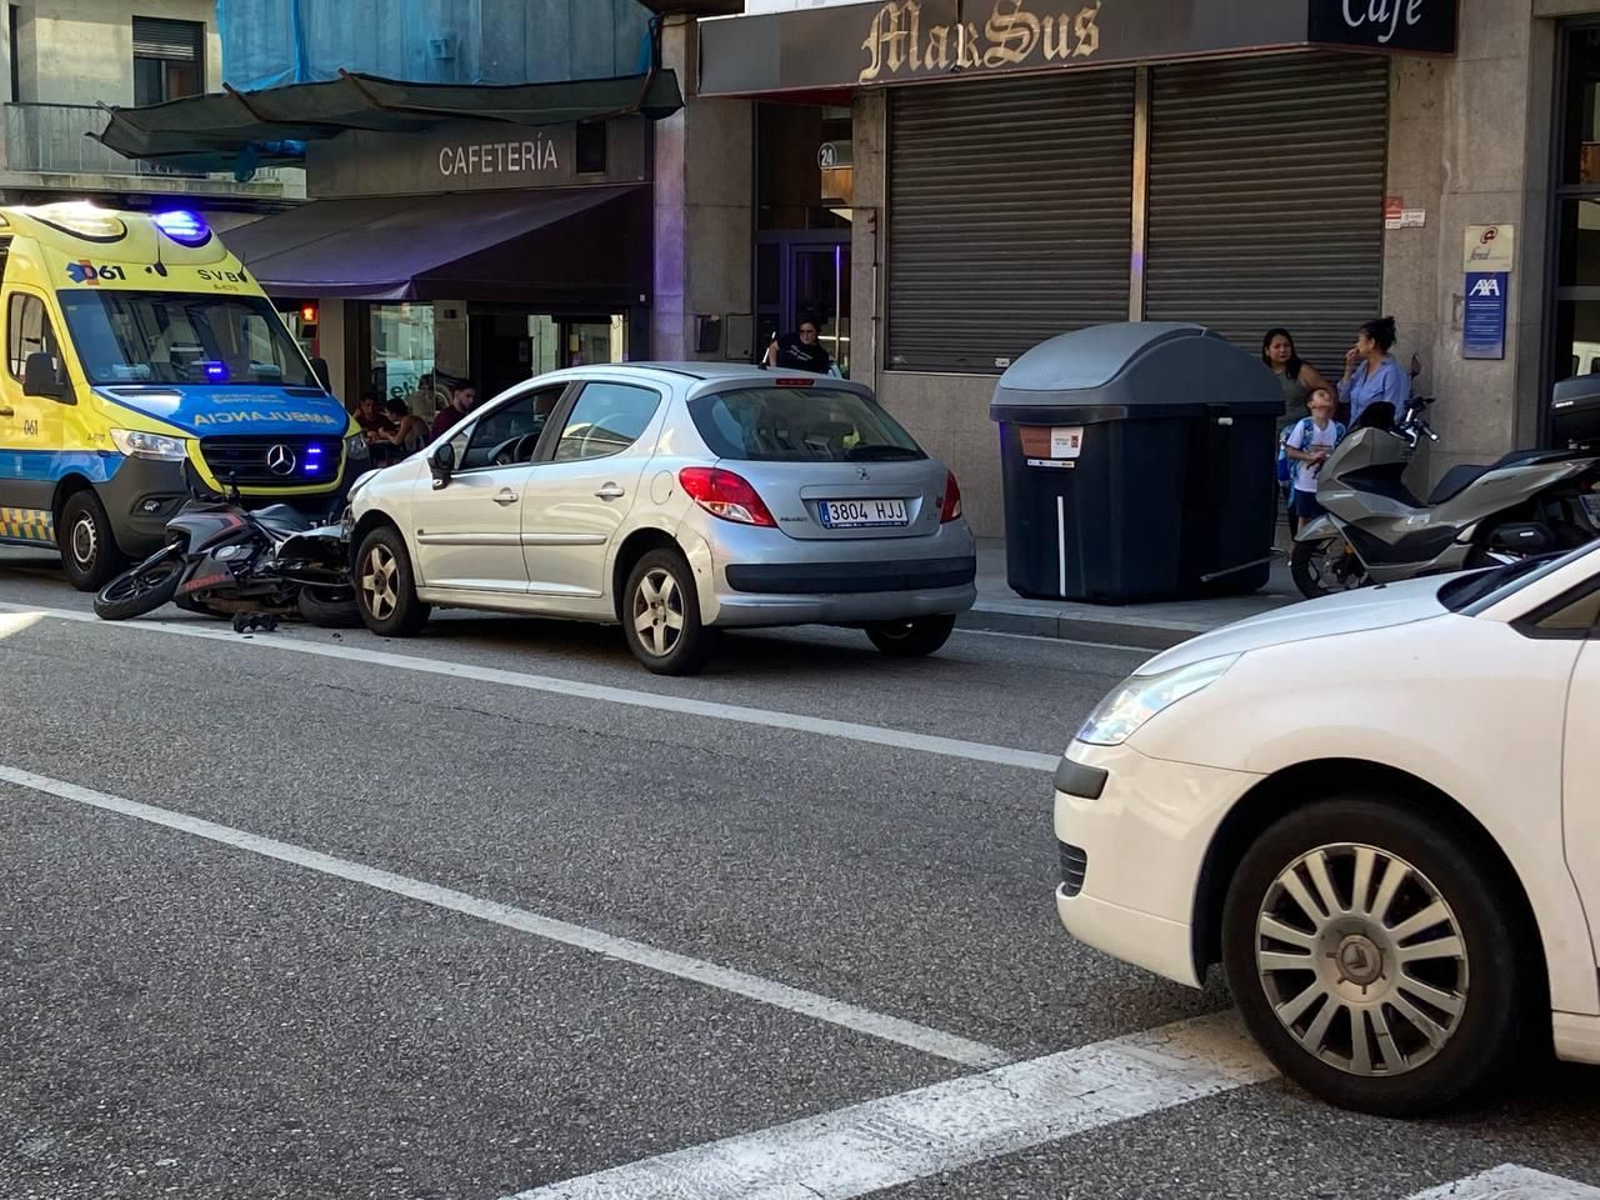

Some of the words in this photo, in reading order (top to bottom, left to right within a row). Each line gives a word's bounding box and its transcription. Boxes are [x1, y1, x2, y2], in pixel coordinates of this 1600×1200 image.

[439, 132, 558, 176] CAFETERÍA
[83, 264, 126, 280] 061
[1469, 279, 1500, 296] AXA
[24, 419, 38, 435] 061
[828, 503, 868, 521] 3804
[876, 502, 903, 519] HJJ
